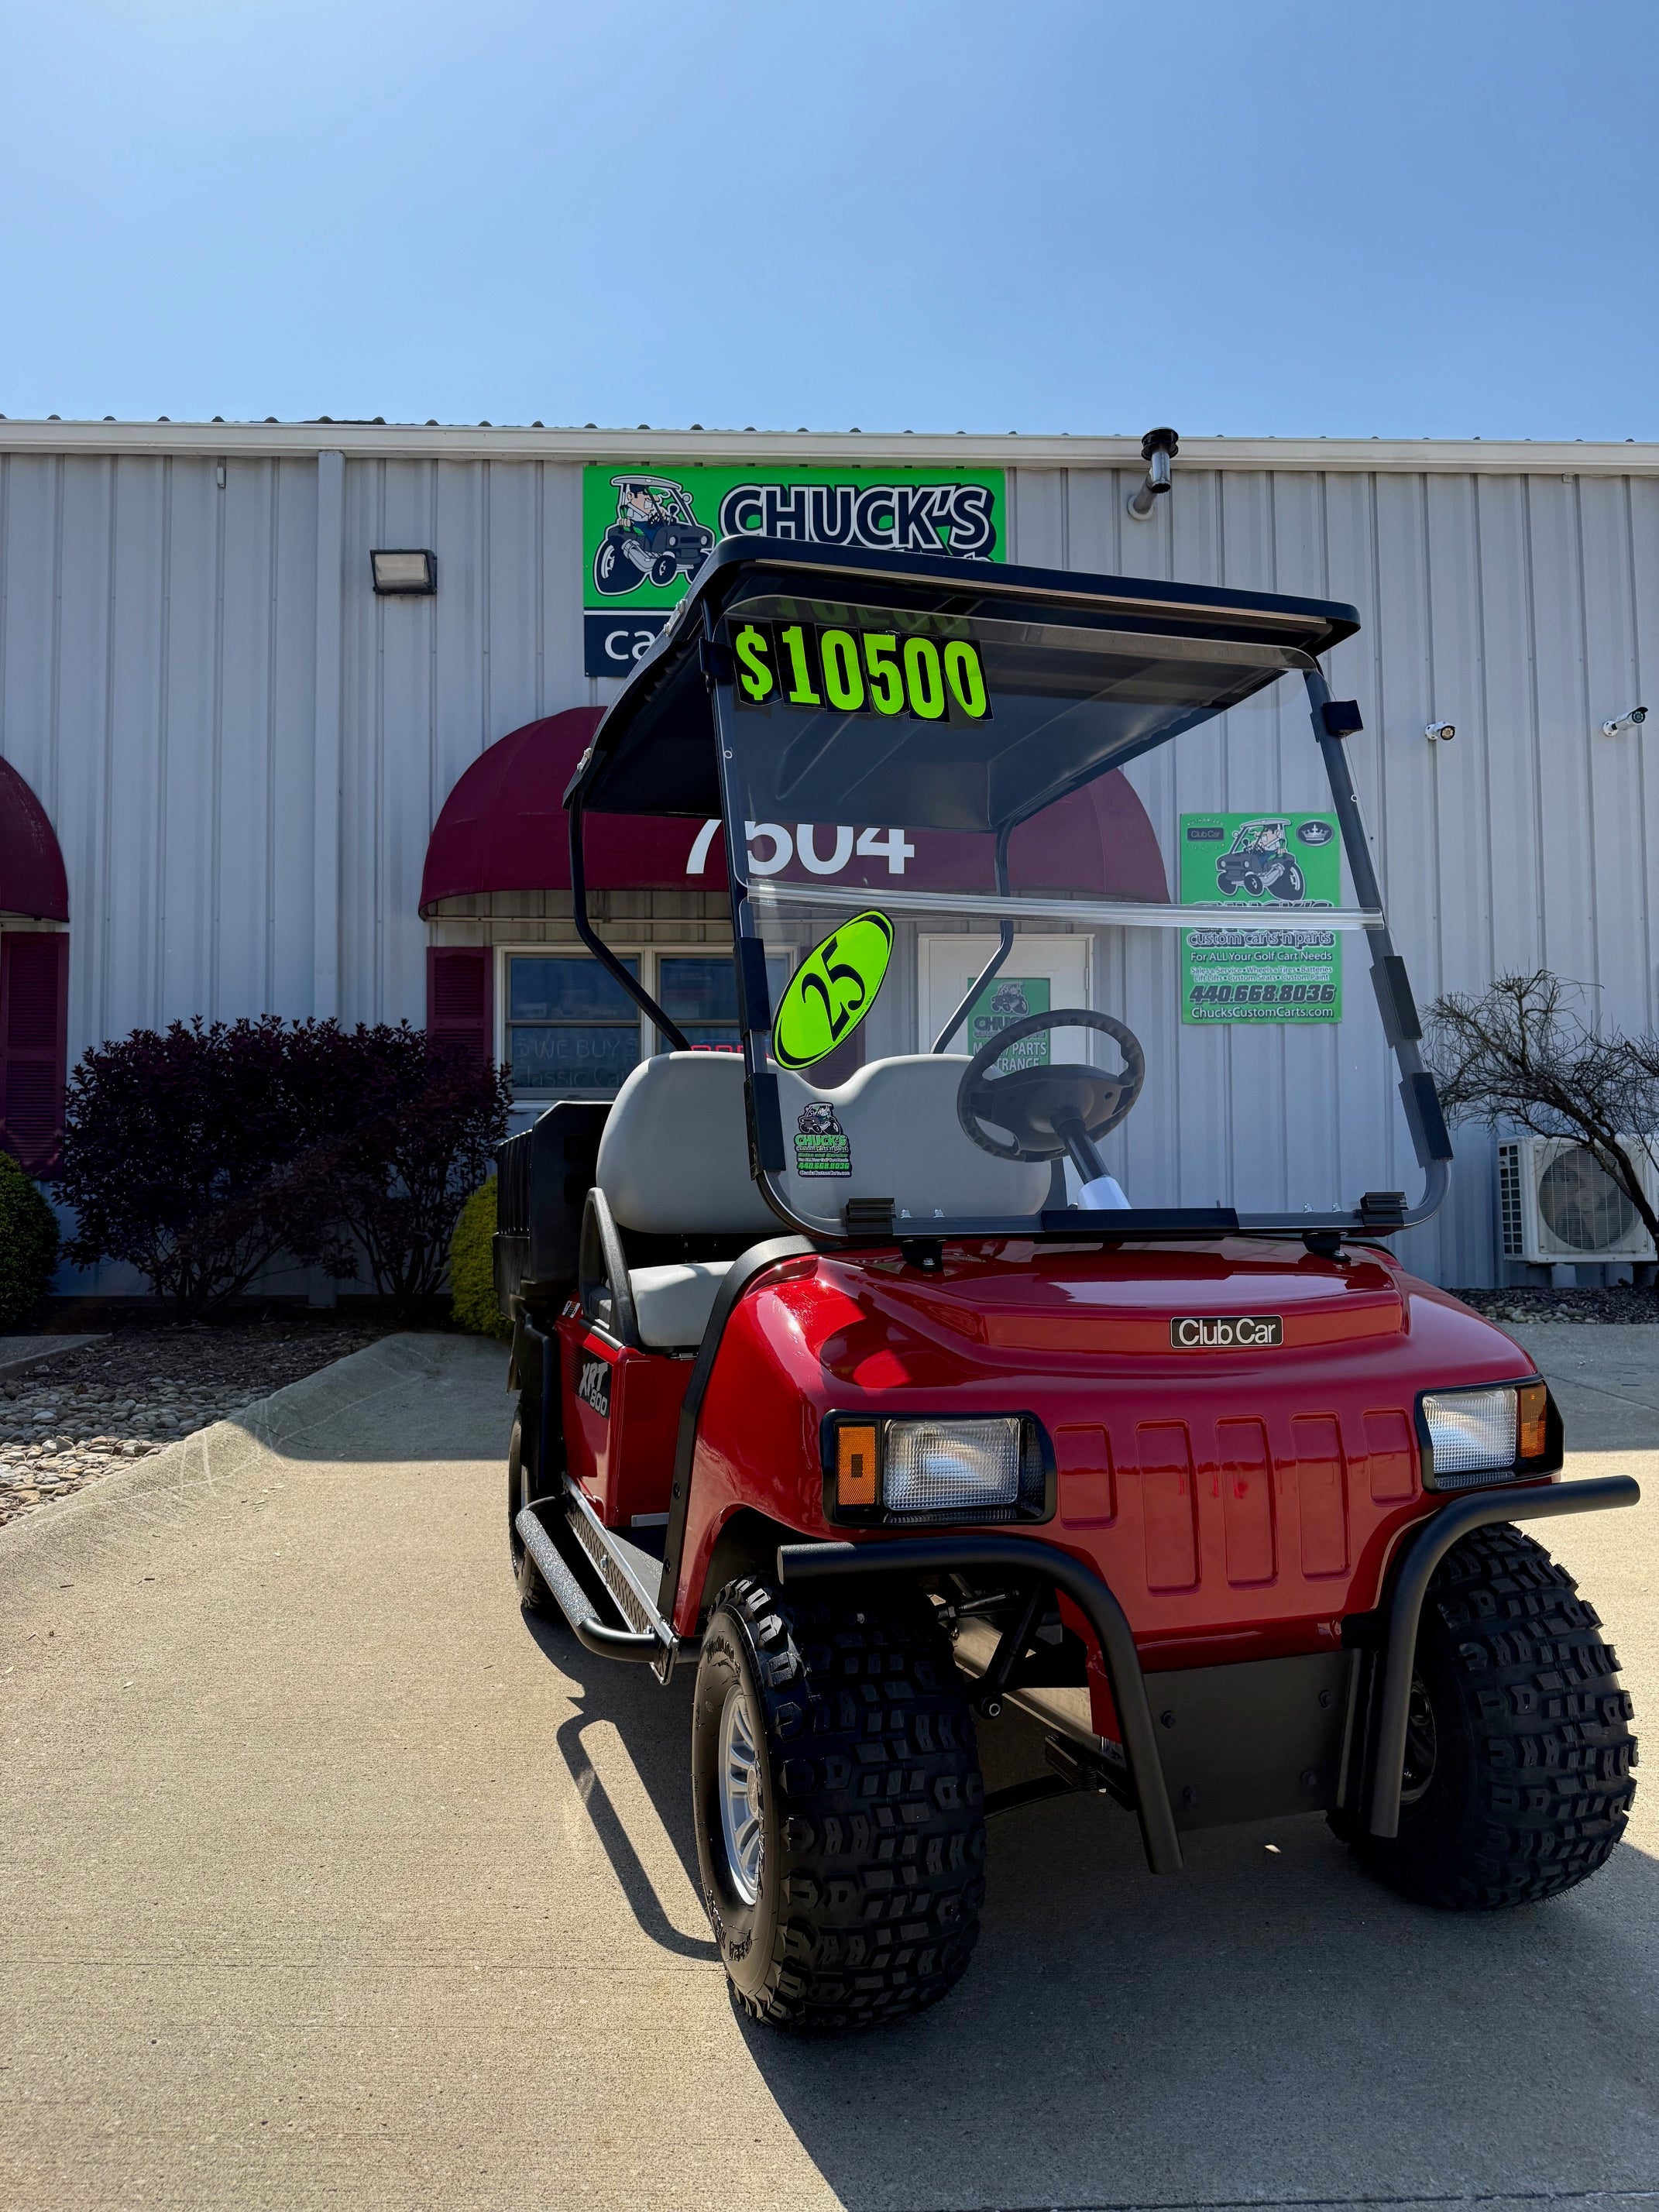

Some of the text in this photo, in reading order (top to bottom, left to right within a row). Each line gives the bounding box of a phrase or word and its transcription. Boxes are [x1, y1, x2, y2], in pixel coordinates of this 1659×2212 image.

[720, 484, 995, 556] CHUCK'S
[604, 630, 656, 661] ca
[736, 625, 987, 719] $10500
[685, 819, 915, 876] 7504
[1189, 933, 1242, 946] custom
[1244, 932, 1279, 945] carts
[1294, 931, 1332, 948] parts
[1190, 950, 1332, 962] For ALL Your Golf Cart Needs
[801, 935, 866, 1042] 25
[1190, 984, 1336, 1003] 440.668.8036
[1191, 1007, 1334, 1018] ChucksCustomCarts.com
[533, 1039, 569, 1059] WE
[576, 1039, 620, 1059] BUY
[1012, 1042, 1048, 1056] PARTS
[795, 1134, 847, 1146] CHUCK'S
[1179, 1318, 1276, 1345] Club Car
[579, 1362, 608, 1397] XRT
[589, 1389, 608, 1416] 800
